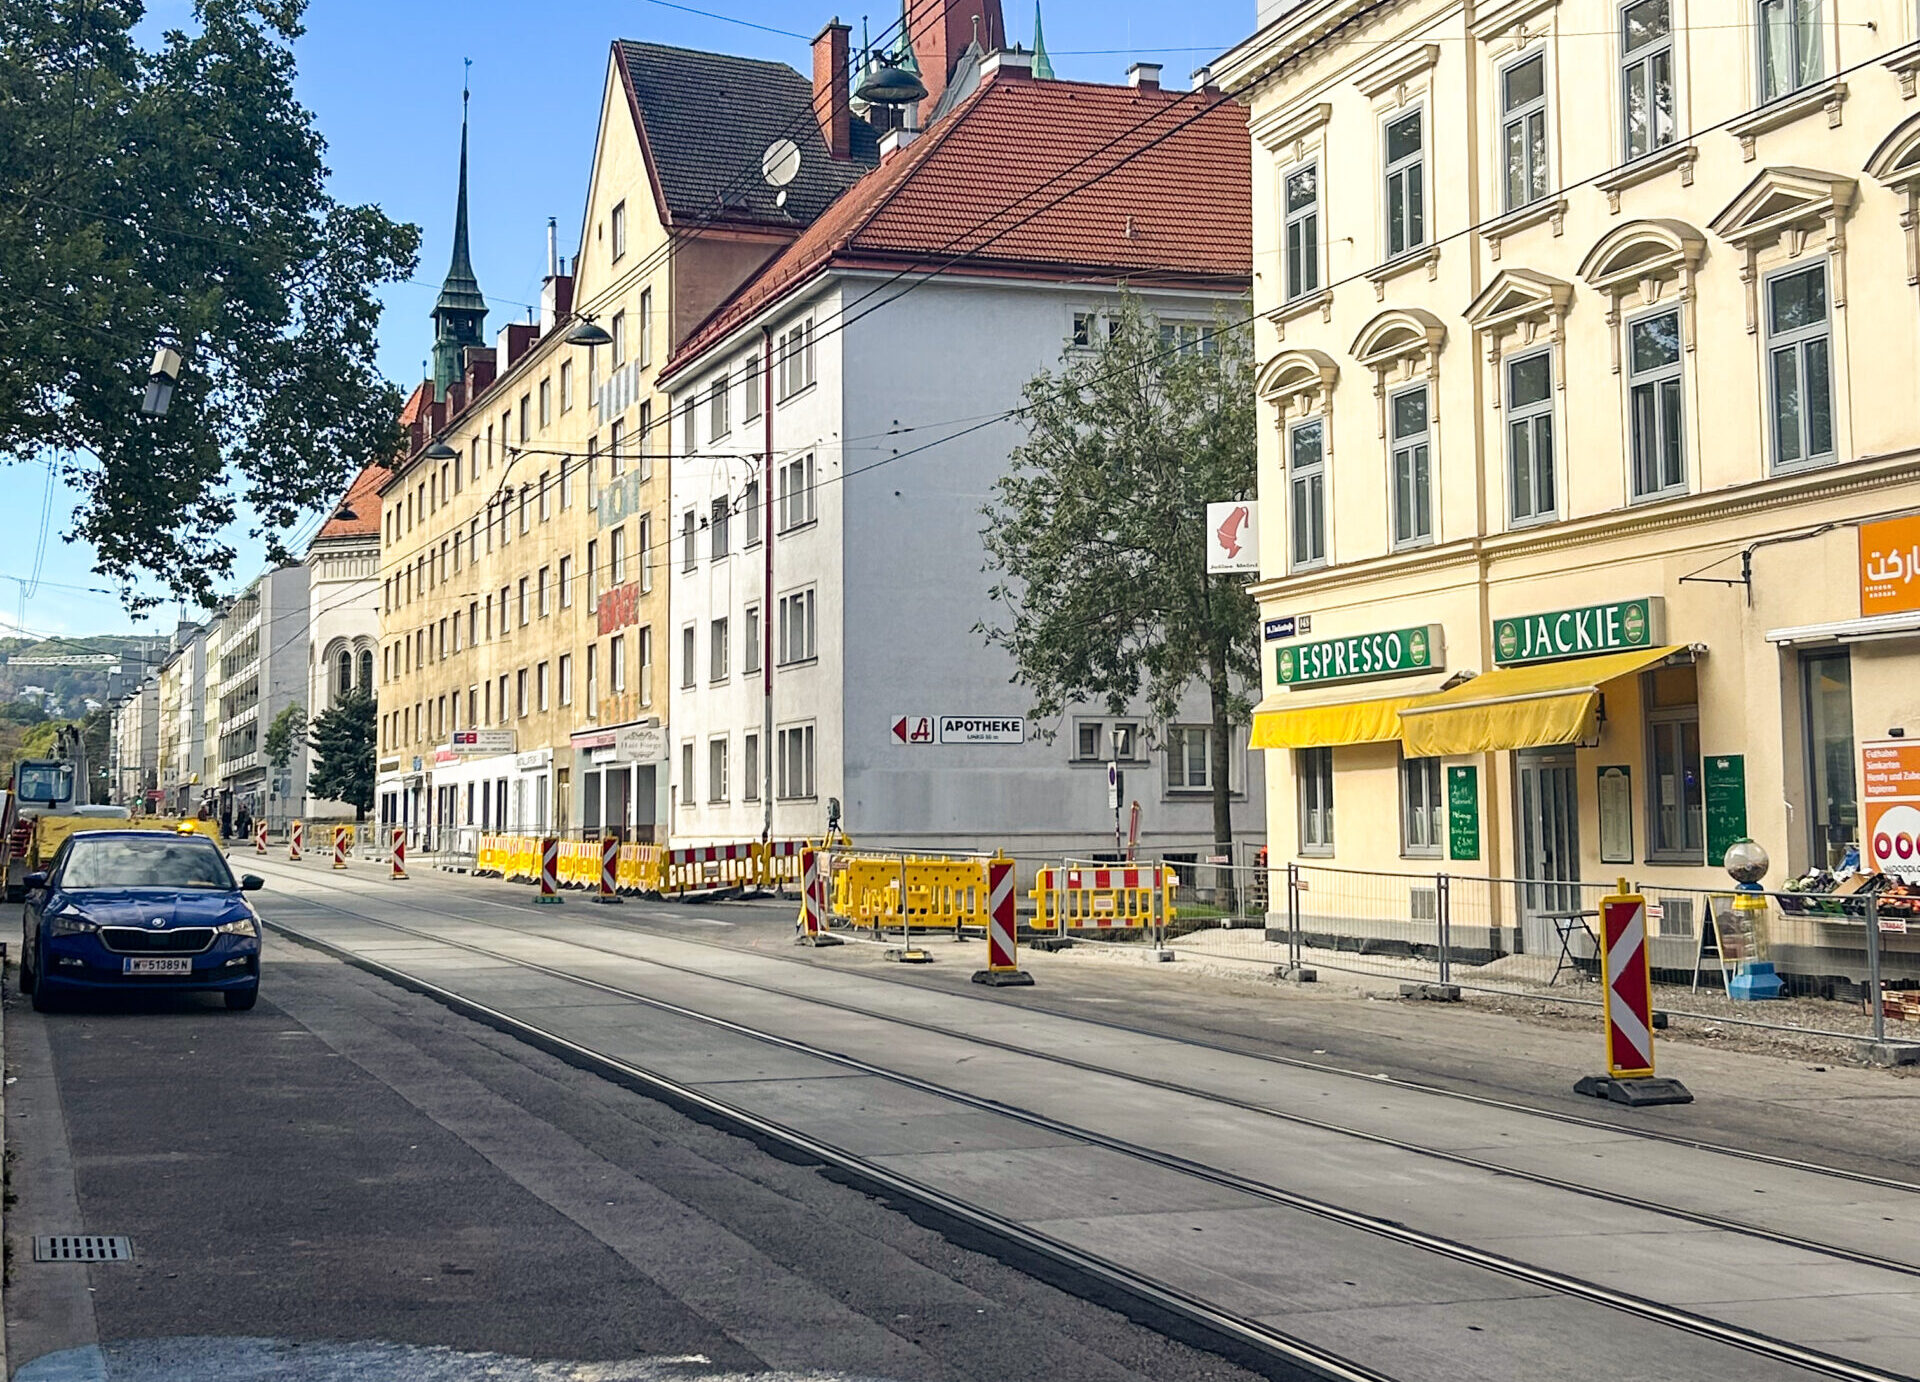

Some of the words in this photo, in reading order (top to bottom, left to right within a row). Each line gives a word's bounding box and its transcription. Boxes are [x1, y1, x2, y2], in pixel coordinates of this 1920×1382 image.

[1521, 606, 1620, 657] JACKIE
[1300, 633, 1402, 680] ESPRESSO
[944, 720, 1020, 732] APOTHEKE
[1889, 772, 1902, 781] und
[133, 960, 141, 969] W
